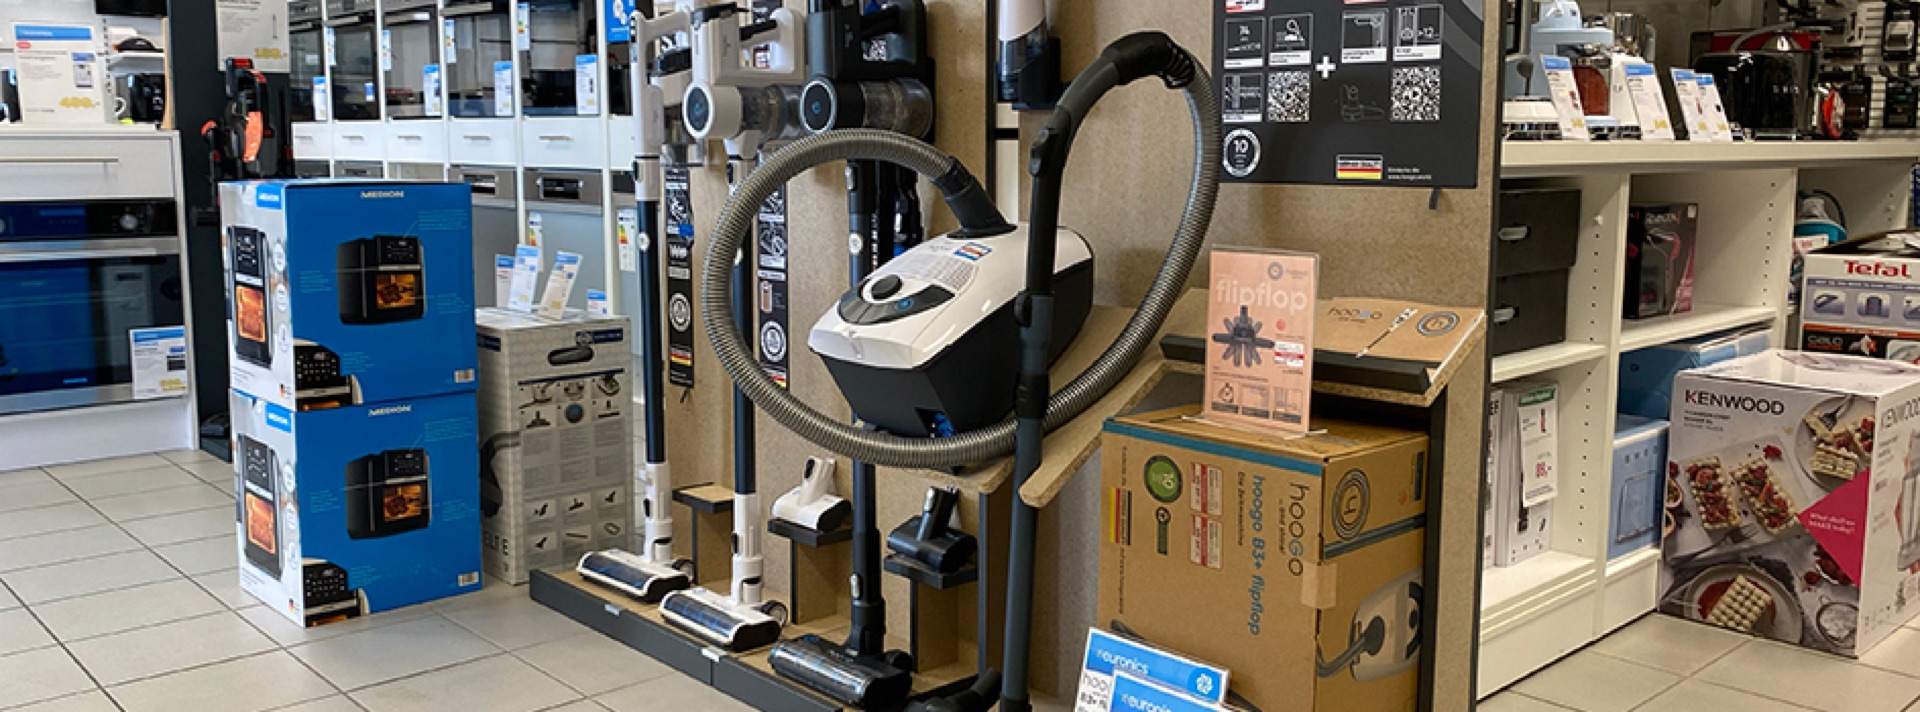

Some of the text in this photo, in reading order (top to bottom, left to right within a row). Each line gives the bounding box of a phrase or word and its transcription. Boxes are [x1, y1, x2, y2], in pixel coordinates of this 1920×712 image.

[1843, 259, 1913, 279] Tefal
[1215, 280, 1308, 316] flipflop
[1684, 388, 1785, 416] KENWOOD
[1247, 474, 1266, 636] hoogo B3+ flipflop
